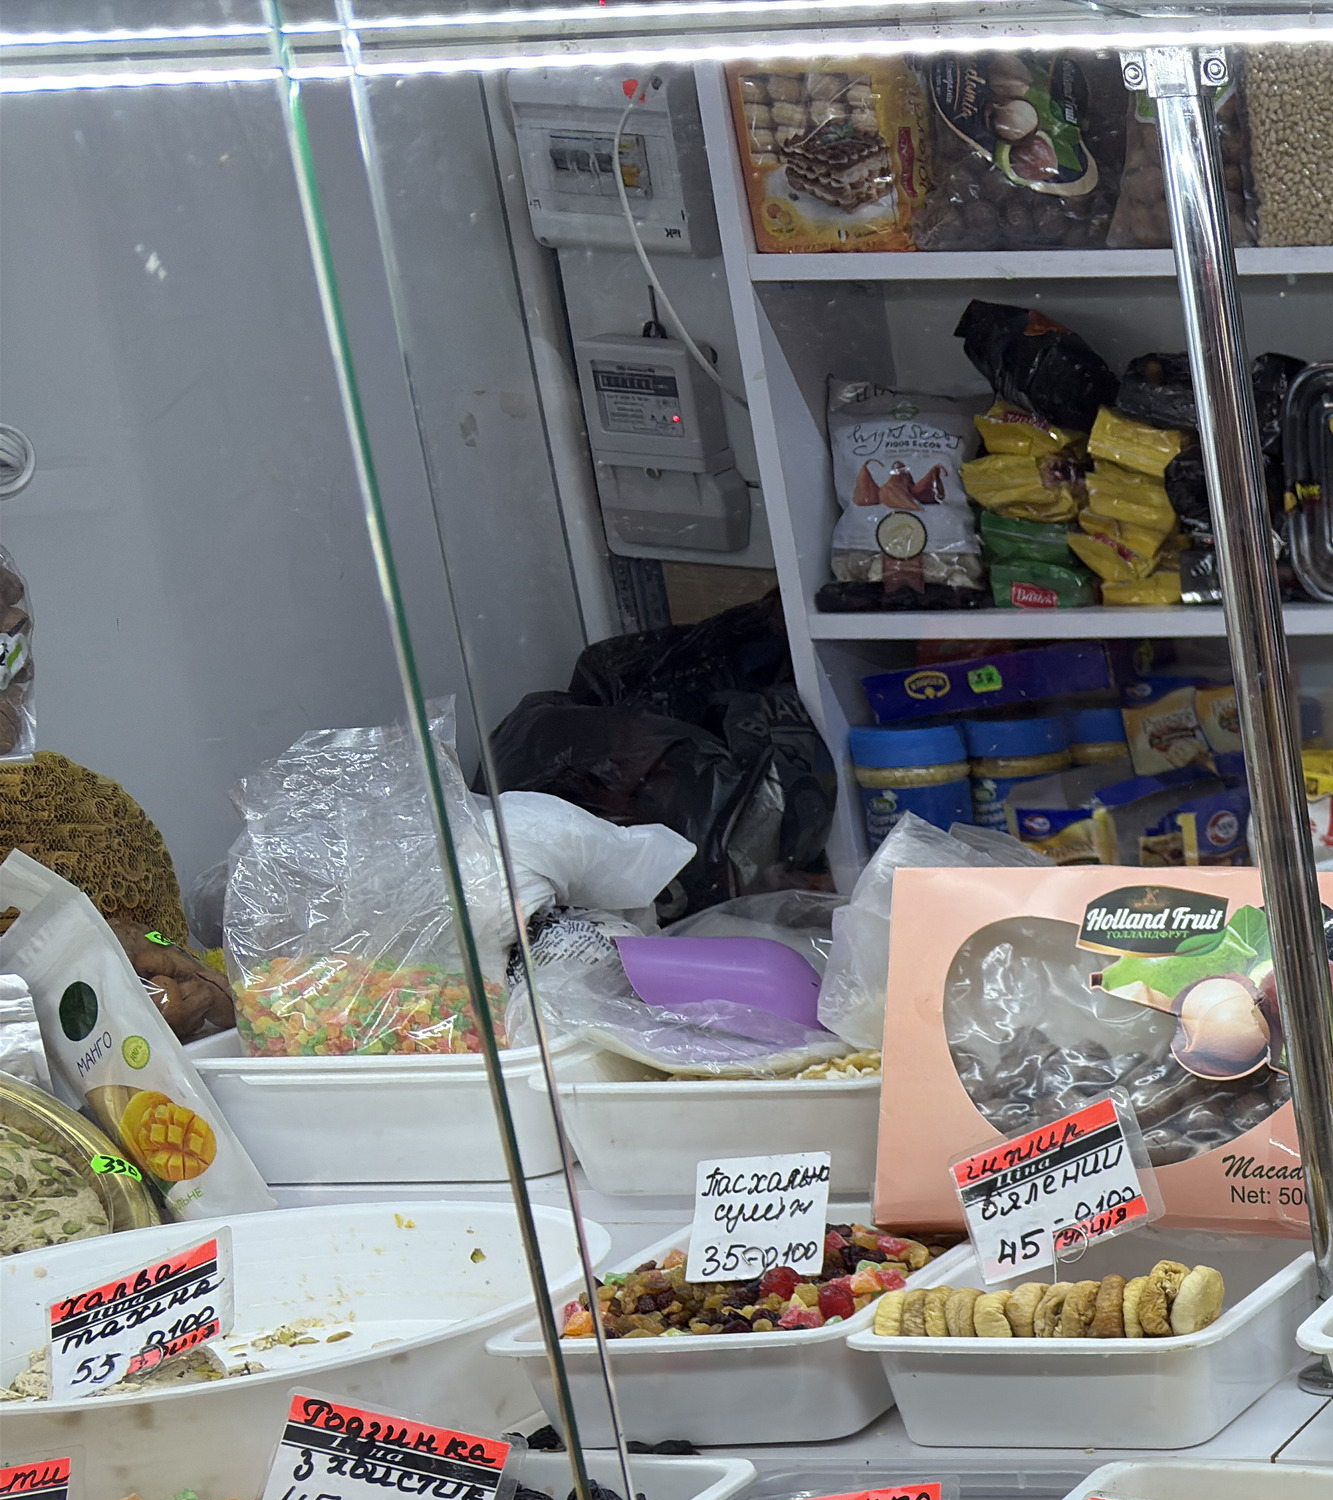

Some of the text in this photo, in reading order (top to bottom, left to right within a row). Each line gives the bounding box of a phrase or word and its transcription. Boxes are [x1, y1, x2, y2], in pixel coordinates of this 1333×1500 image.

[1086, 907, 1224, 932] Holland Fruit
[1106, 928, 1191, 940] ГОЛЛАНДФРУТ
[75, 1030, 113, 1078] МАНГО
[995, 1157, 1050, 1188] Ціна
[1222, 1153, 1304, 1179] Macad
[1230, 1185, 1274, 1206] Net:
